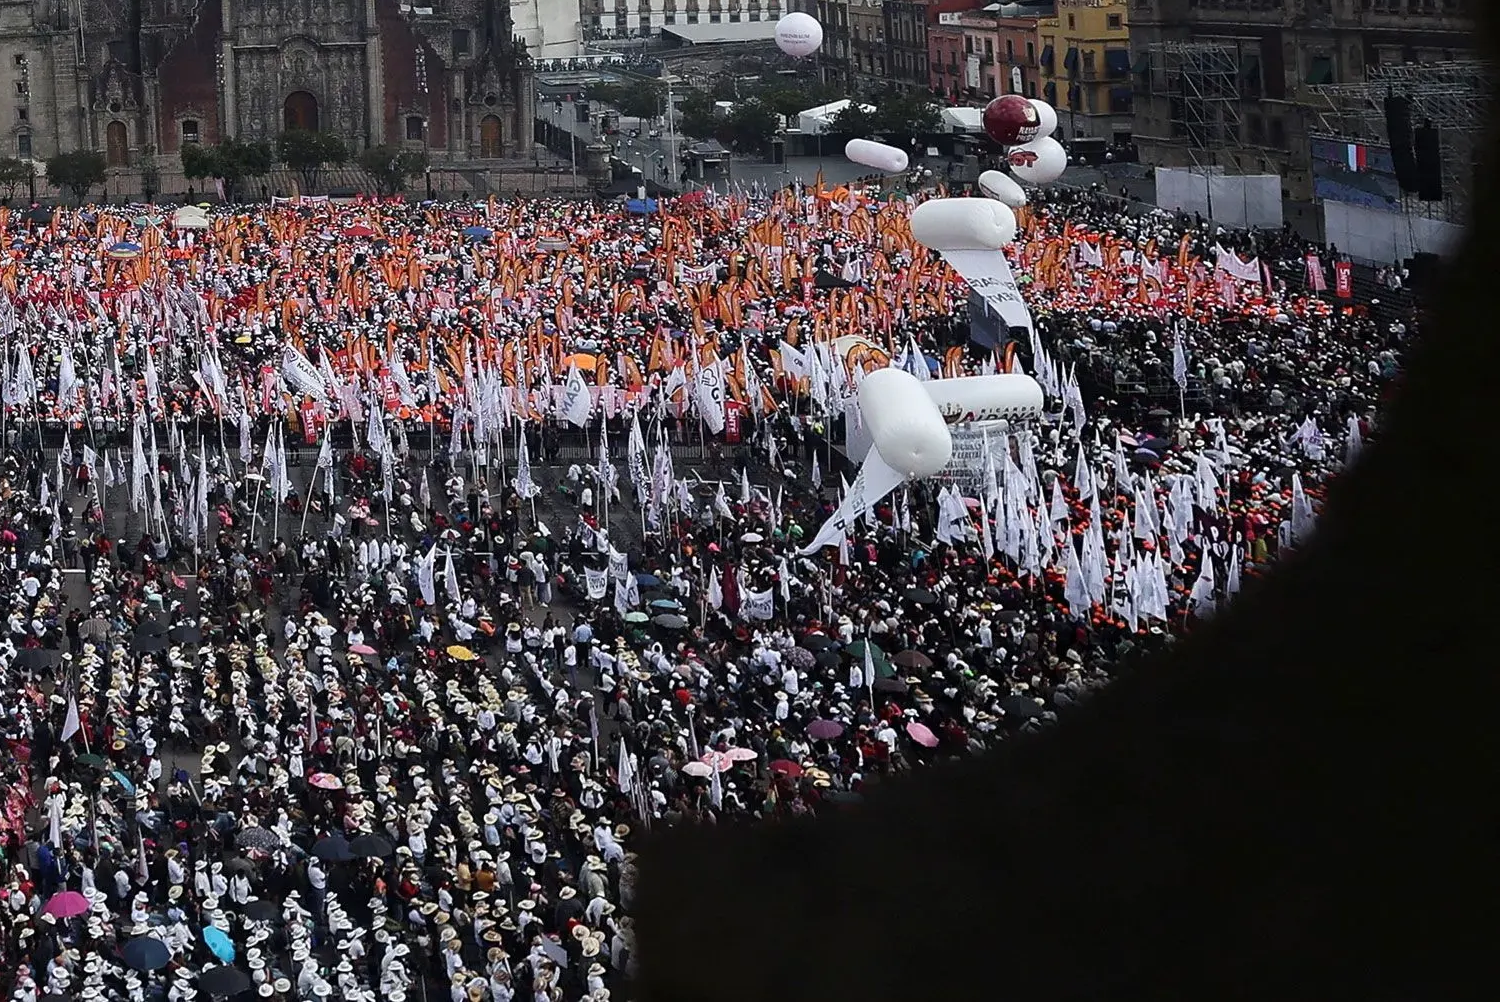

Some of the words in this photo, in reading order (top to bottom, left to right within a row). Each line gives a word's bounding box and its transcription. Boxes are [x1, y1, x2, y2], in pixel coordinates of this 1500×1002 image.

[305, 409, 316, 434] SNTE
[727, 408, 739, 434] SNTE
[981, 406, 1036, 414] RICARDO
